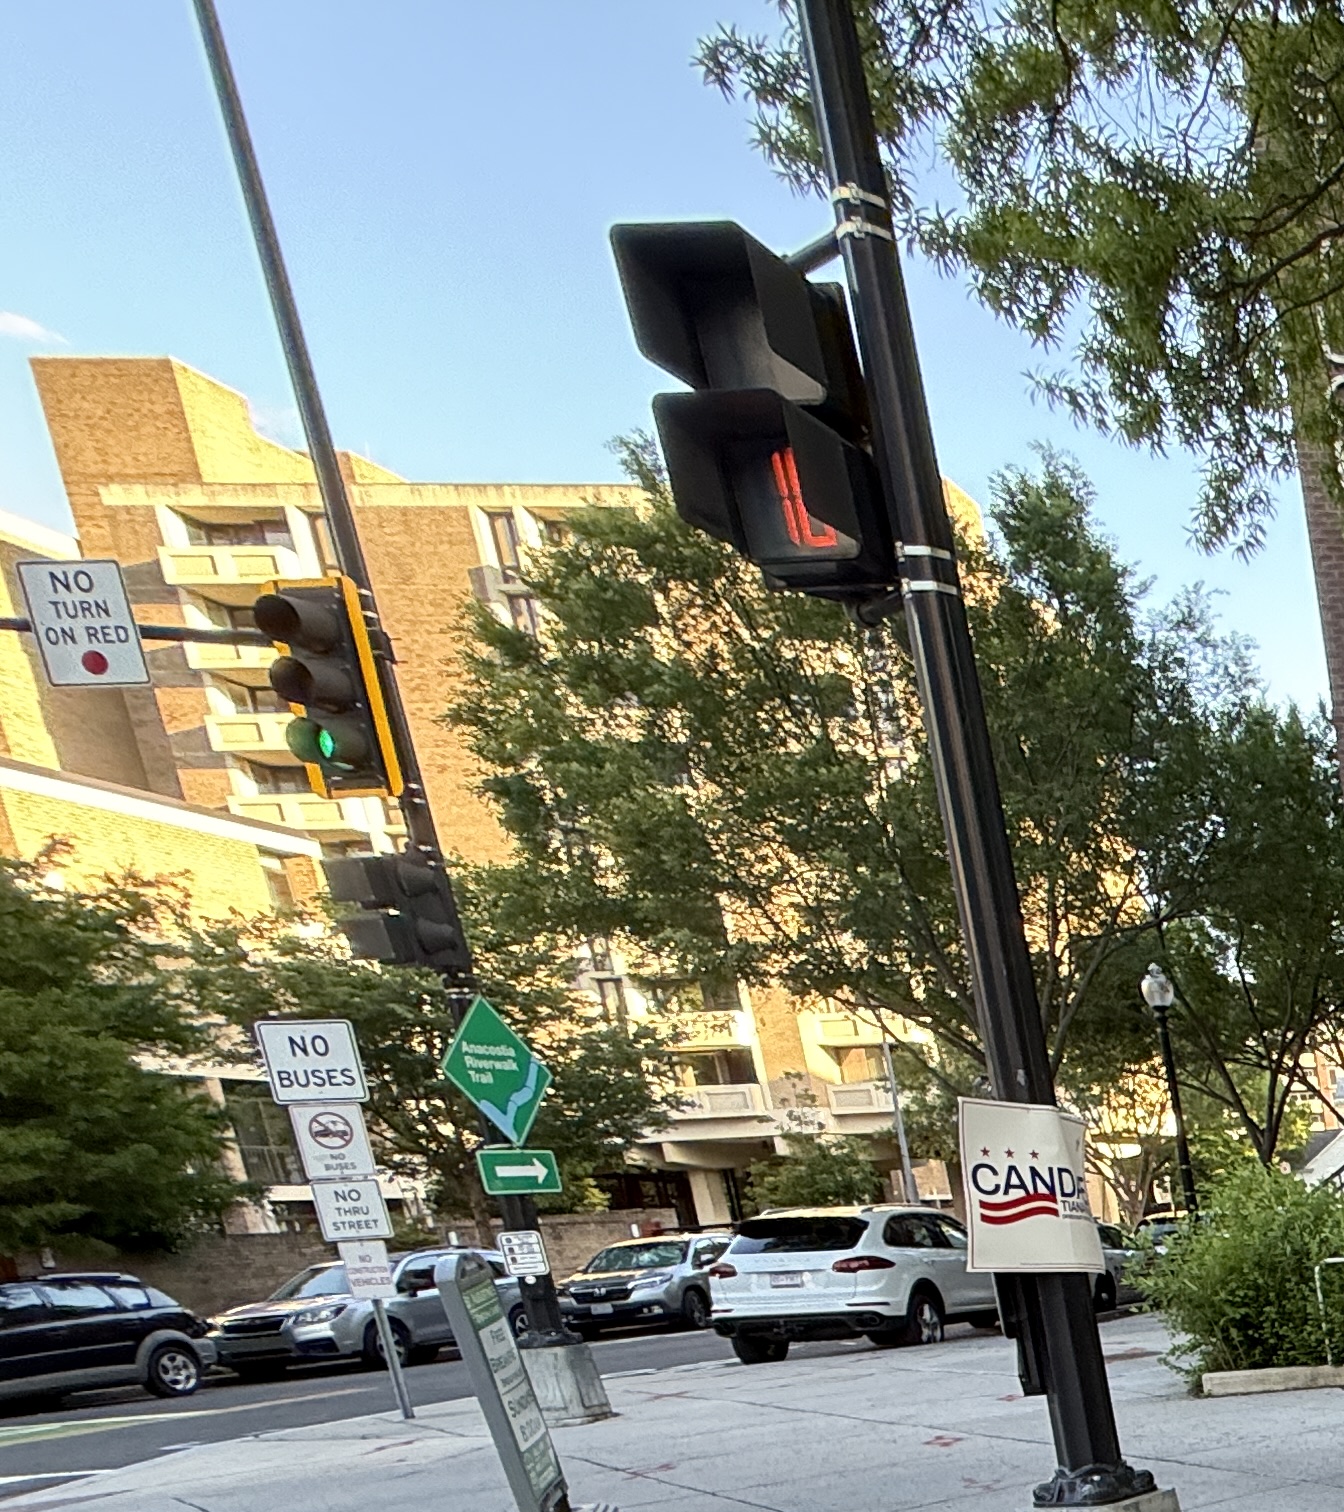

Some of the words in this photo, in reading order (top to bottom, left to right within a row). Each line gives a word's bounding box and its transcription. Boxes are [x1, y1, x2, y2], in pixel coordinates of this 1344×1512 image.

[48, 570, 94, 595] NO
[48, 599, 111, 620] TURN
[45, 626, 77, 646] ON
[85, 625, 129, 645] RED
[288, 1035, 330, 1057] NO
[461, 1041, 516, 1057] Anacostia
[464, 1056, 519, 1071] Riverwalk
[277, 1068, 356, 1088] BUSES
[467, 1070, 494, 1084] Trail
[329, 1152, 346, 1161] NO
[324, 1162, 357, 1171] BUSES
[334, 1189, 361, 1203] NO
[335, 1206, 369, 1217] THRU
[332, 1219, 379, 1231] STREET
